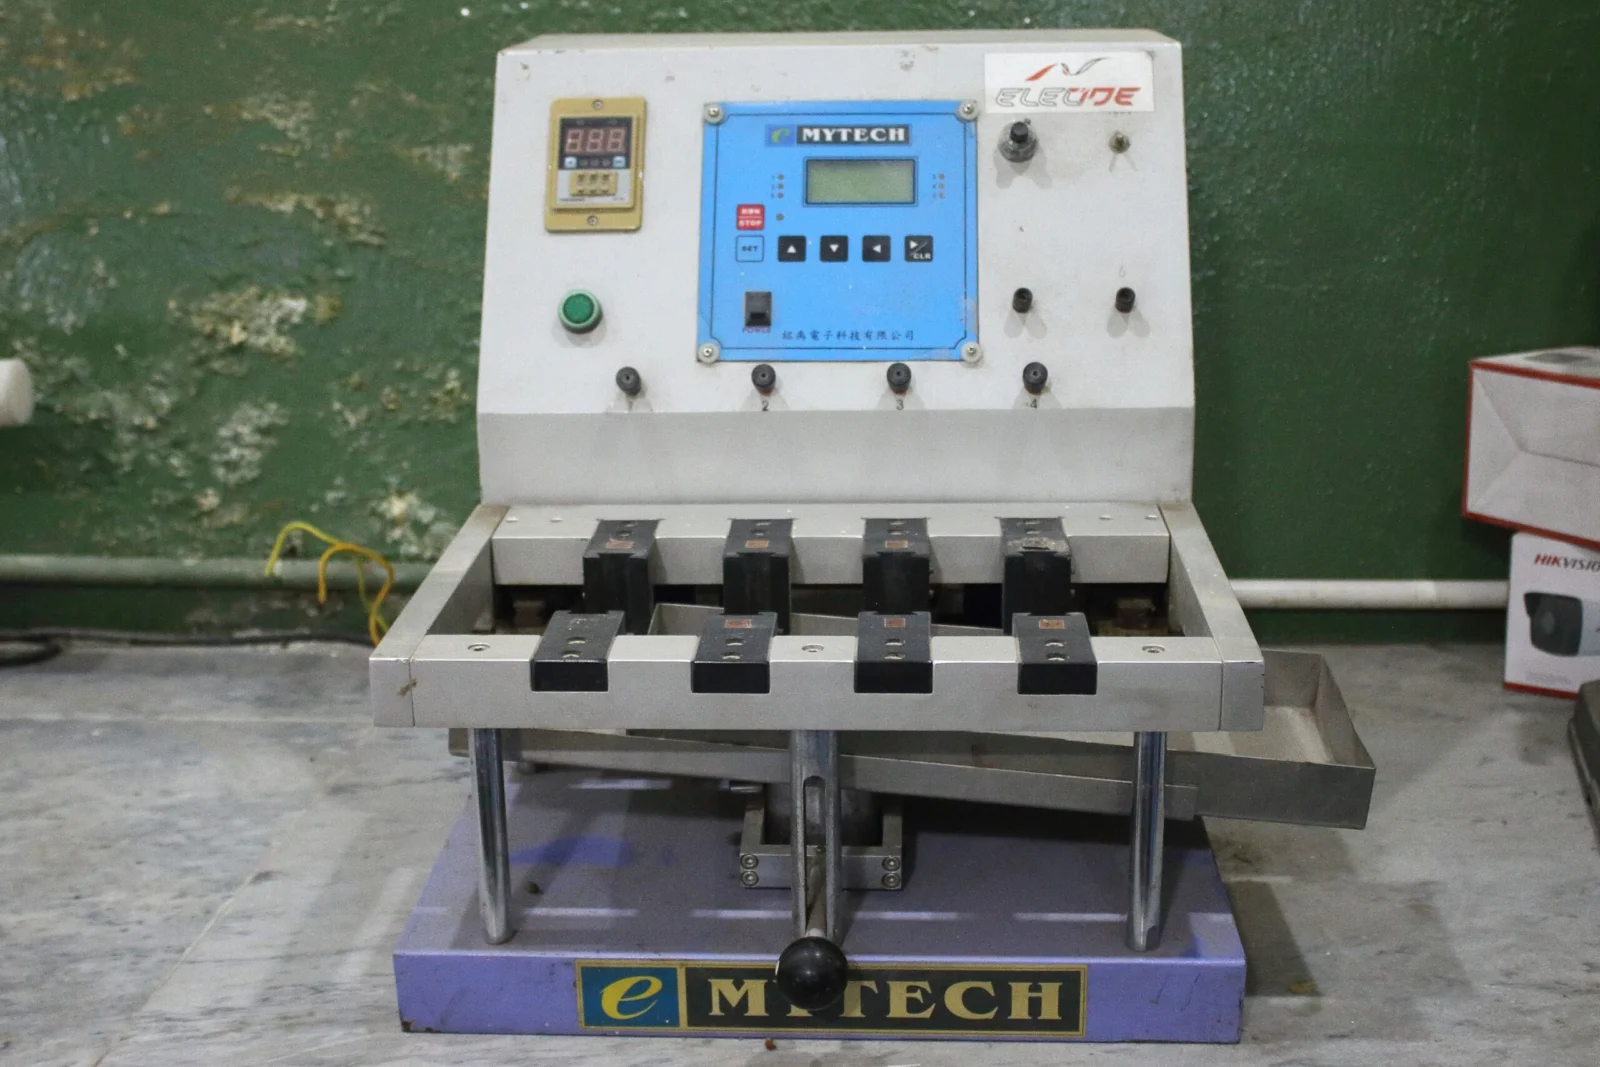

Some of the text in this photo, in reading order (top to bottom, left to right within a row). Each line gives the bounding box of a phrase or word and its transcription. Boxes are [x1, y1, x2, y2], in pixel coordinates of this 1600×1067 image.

[802, 127, 905, 142] MYTECH
[738, 219, 763, 227] STOP
[761, 400, 769, 412] 2
[896, 399, 904, 411] 3
[1030, 399, 1038, 409] 4
[707, 977, 1064, 1021] MTECH
